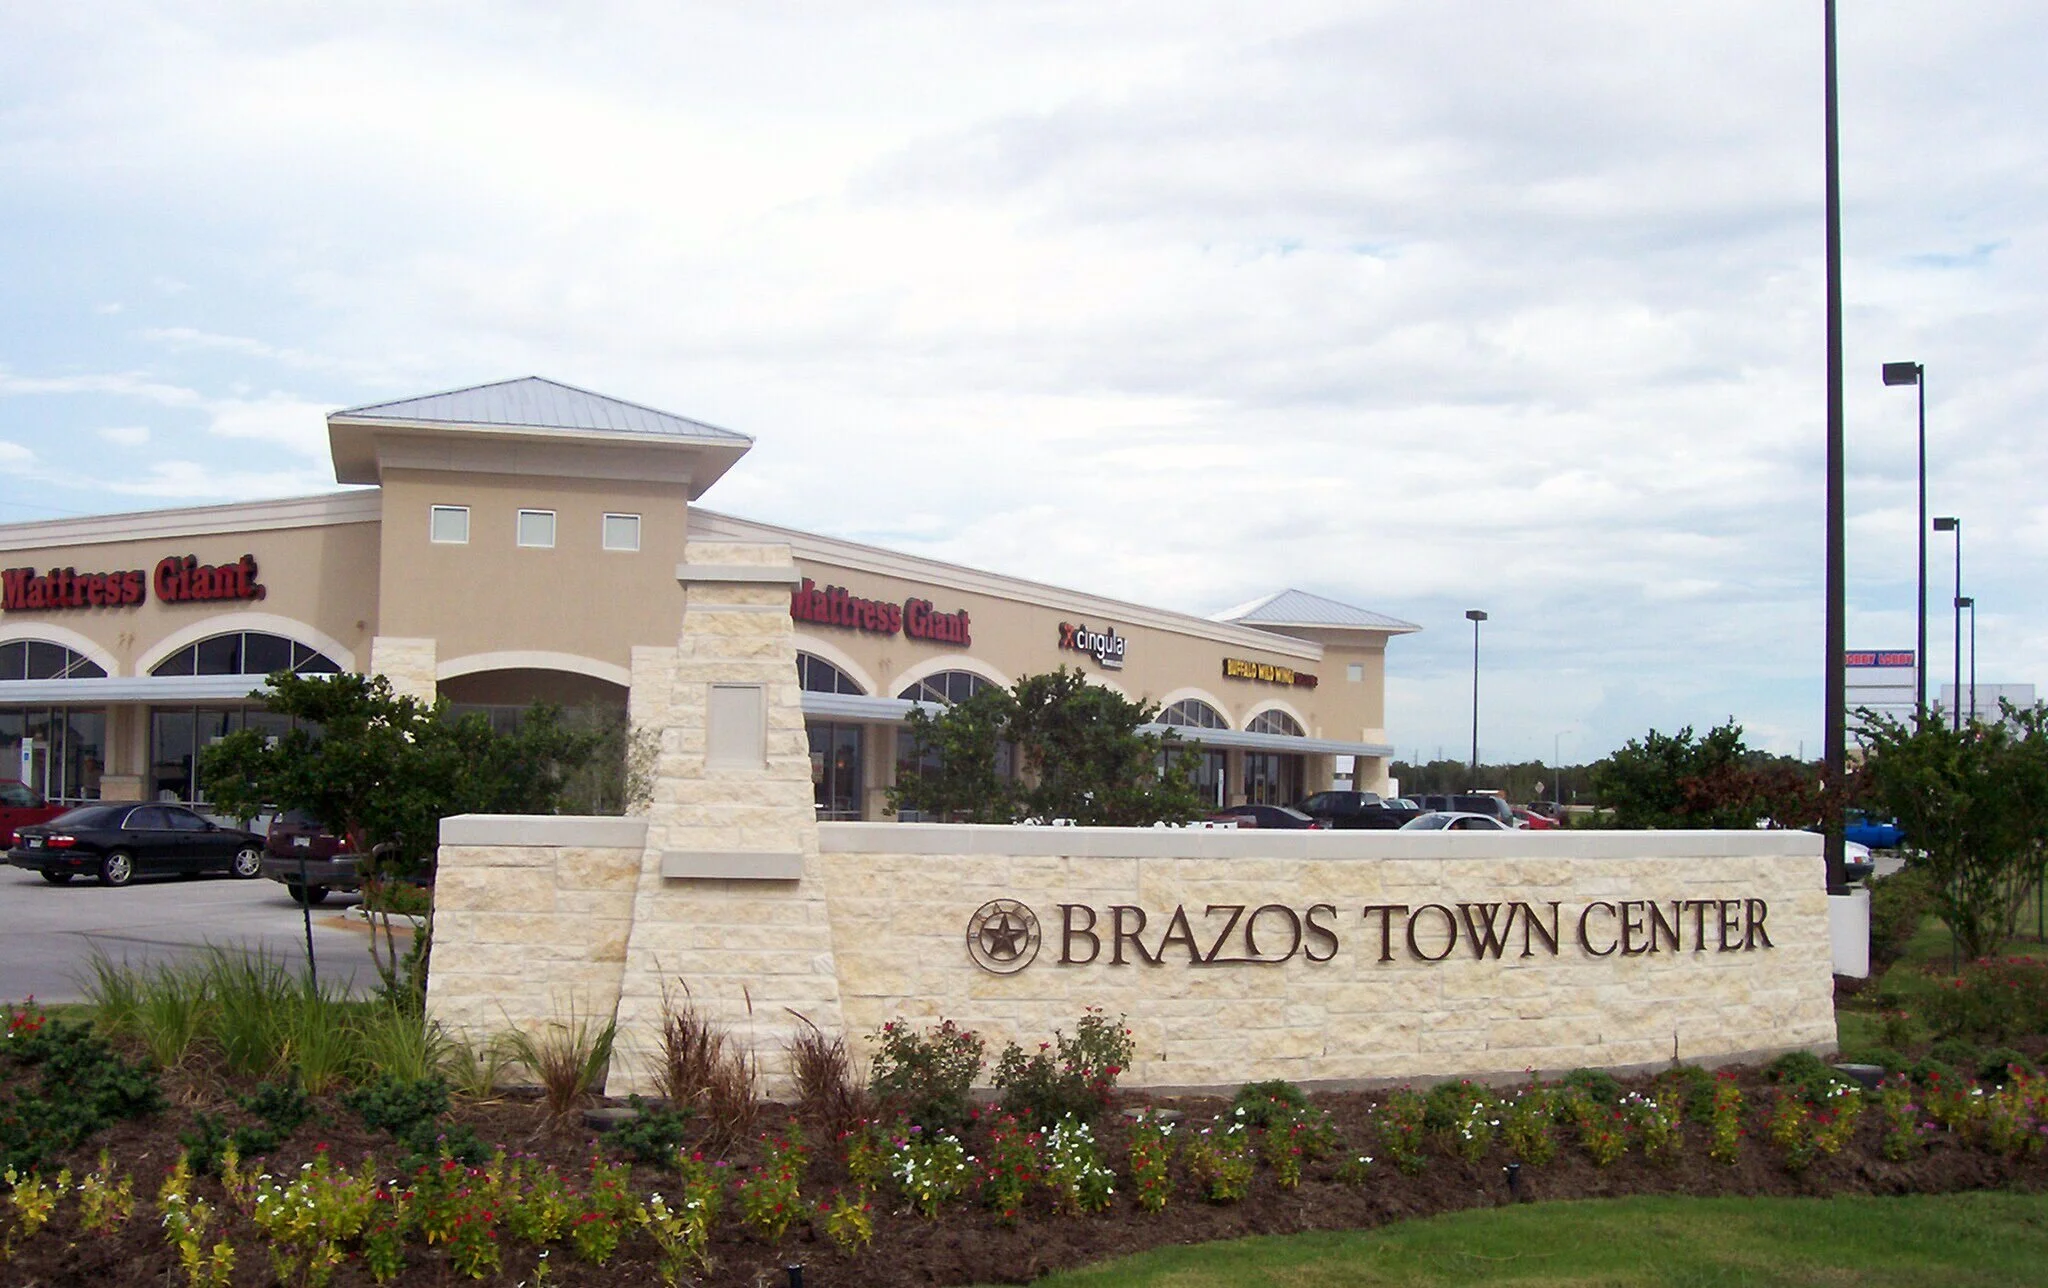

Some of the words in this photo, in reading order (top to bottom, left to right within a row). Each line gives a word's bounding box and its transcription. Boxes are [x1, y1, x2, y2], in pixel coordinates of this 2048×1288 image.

[1, 567, 146, 611] Mattress
[1076, 624, 1128, 659] cingular
[1879, 653, 1913, 665] LOBBY
[1057, 903, 1340, 965] BRAZOS
[1363, 901, 1562, 962] TOWN
[1578, 898, 1775, 957] CENTER
